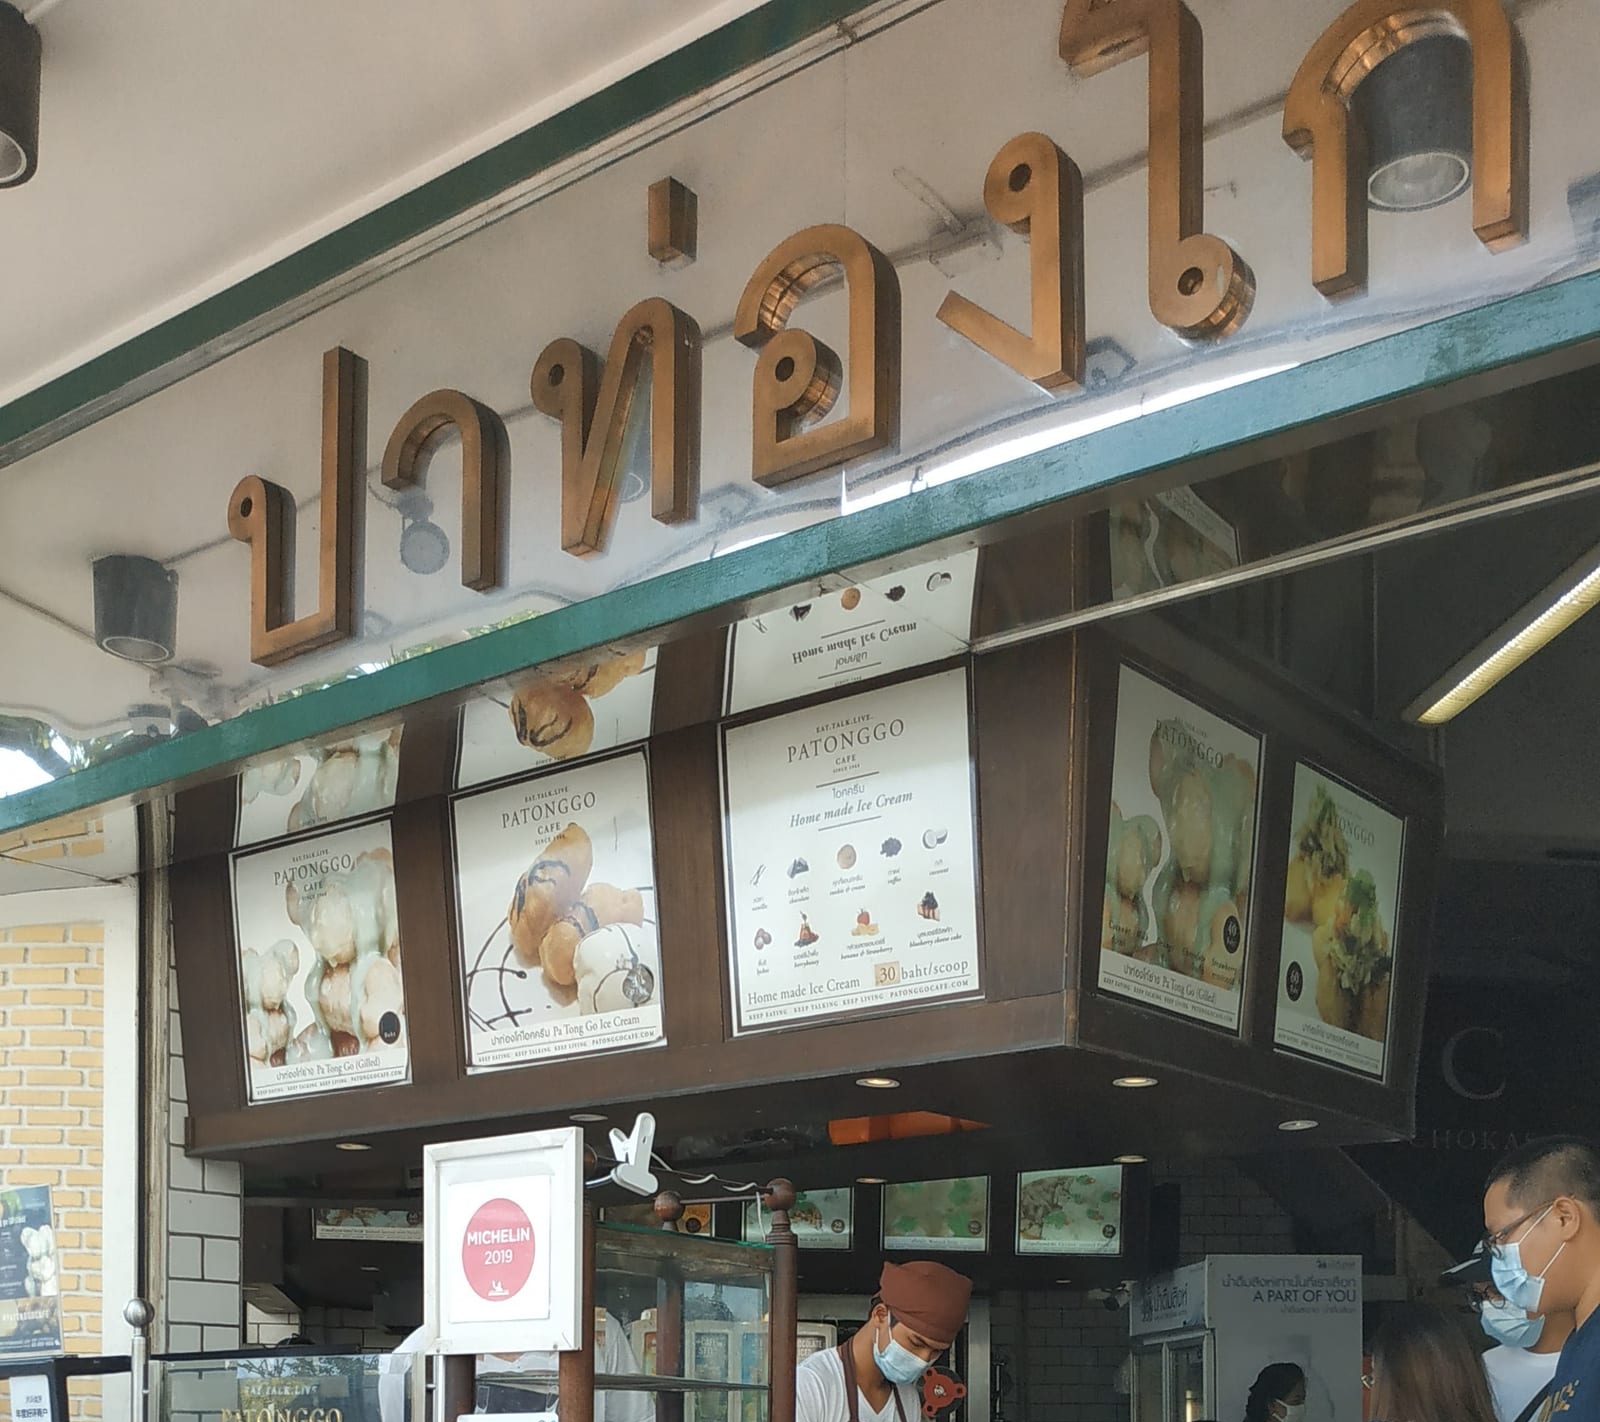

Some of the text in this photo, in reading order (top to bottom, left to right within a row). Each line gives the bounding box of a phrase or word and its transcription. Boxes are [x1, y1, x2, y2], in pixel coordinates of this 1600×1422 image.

[787, 718, 905, 763] PATONGGO
[1156, 719, 1224, 769] PATONGGO
[835, 754, 856, 765] CAFE
[502, 792, 596, 829] PATONGGO
[790, 791, 913, 828] Home made Ice Cream
[537, 822, 561, 835] CAFE
[274, 854, 351, 886] PATONGGO
[304, 880, 323, 892] CAFE
[748, 960, 969, 1005] Home made Ice Cream 30 baht/scoop
[890, 979, 969, 998] PATONGGOCAFE.COM
[553, 1027, 563, 1037] Pa
[563, 1023, 584, 1037] Tong
[586, 1020, 598, 1032] Go
[600, 1017, 612, 1030] Ice
[613, 1014, 640, 1027] Cream
[326, 1064, 343, 1076] Tong
[343, 1061, 354, 1072] Go
[467, 1227, 530, 1246] MICHELIN
[484, 1249, 513, 1266] 2019
[1253, 1289, 1356, 1302] A PART OF YOU
